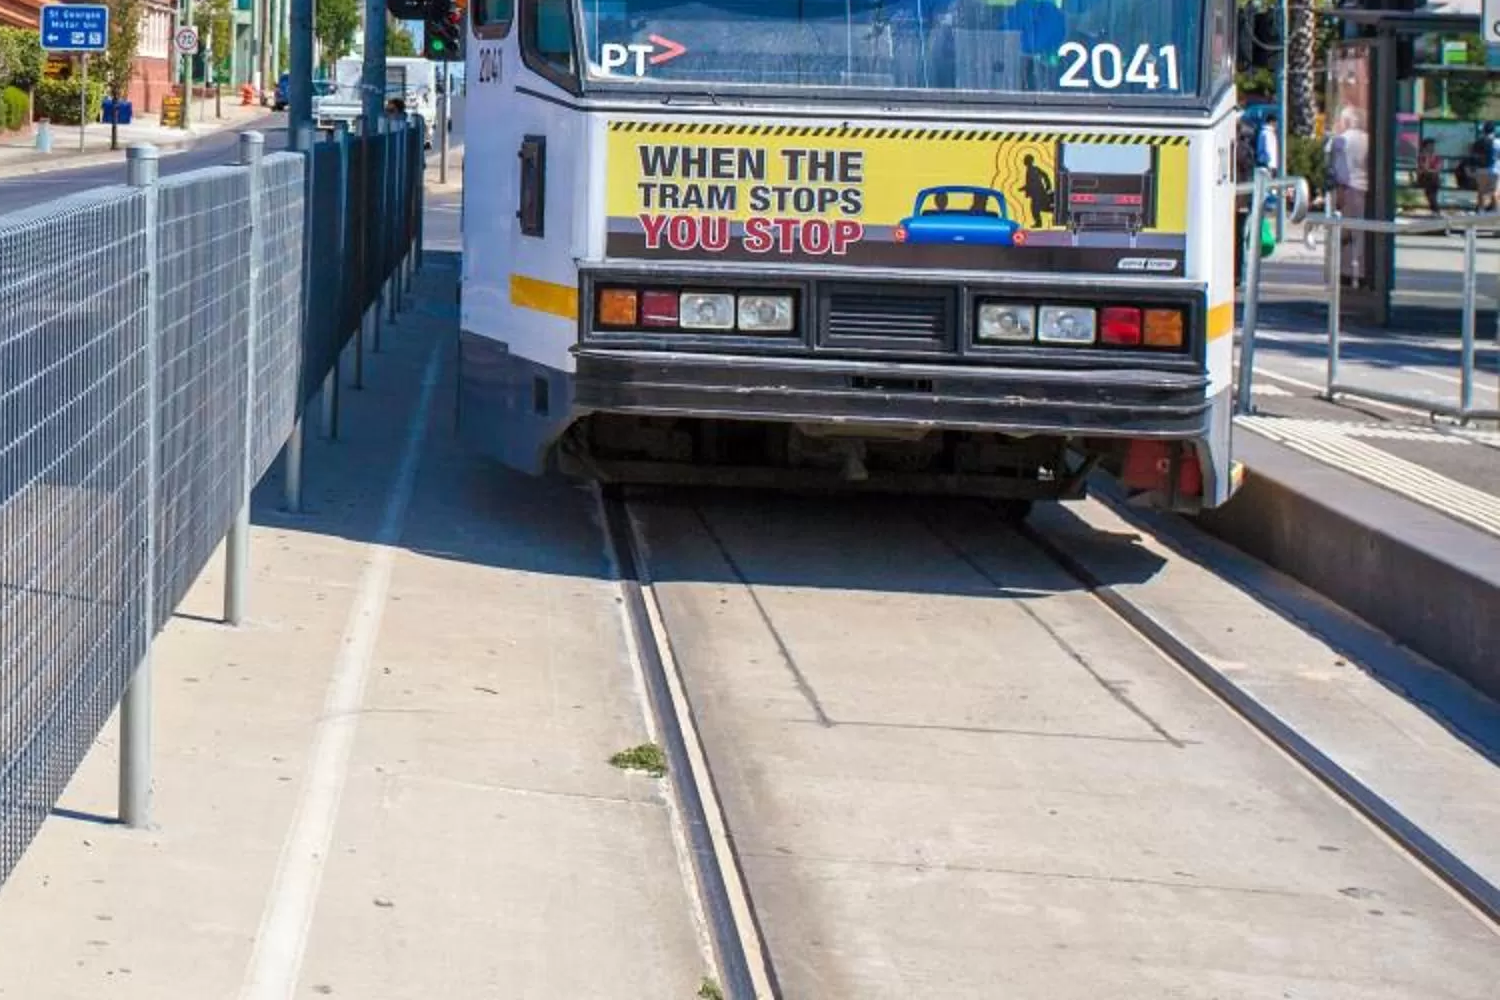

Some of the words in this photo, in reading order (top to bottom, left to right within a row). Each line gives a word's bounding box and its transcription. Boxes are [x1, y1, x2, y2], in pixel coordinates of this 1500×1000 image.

[479, 47, 503, 84] 2041
[1057, 41, 1179, 90] 2041
[638, 145, 765, 181] WHEN
[780, 149, 863, 183] THE
[637, 182, 737, 211] TRAM
[749, 185, 863, 214] STOPS
[638, 213, 731, 251] YOU
[743, 216, 863, 255] STOP
